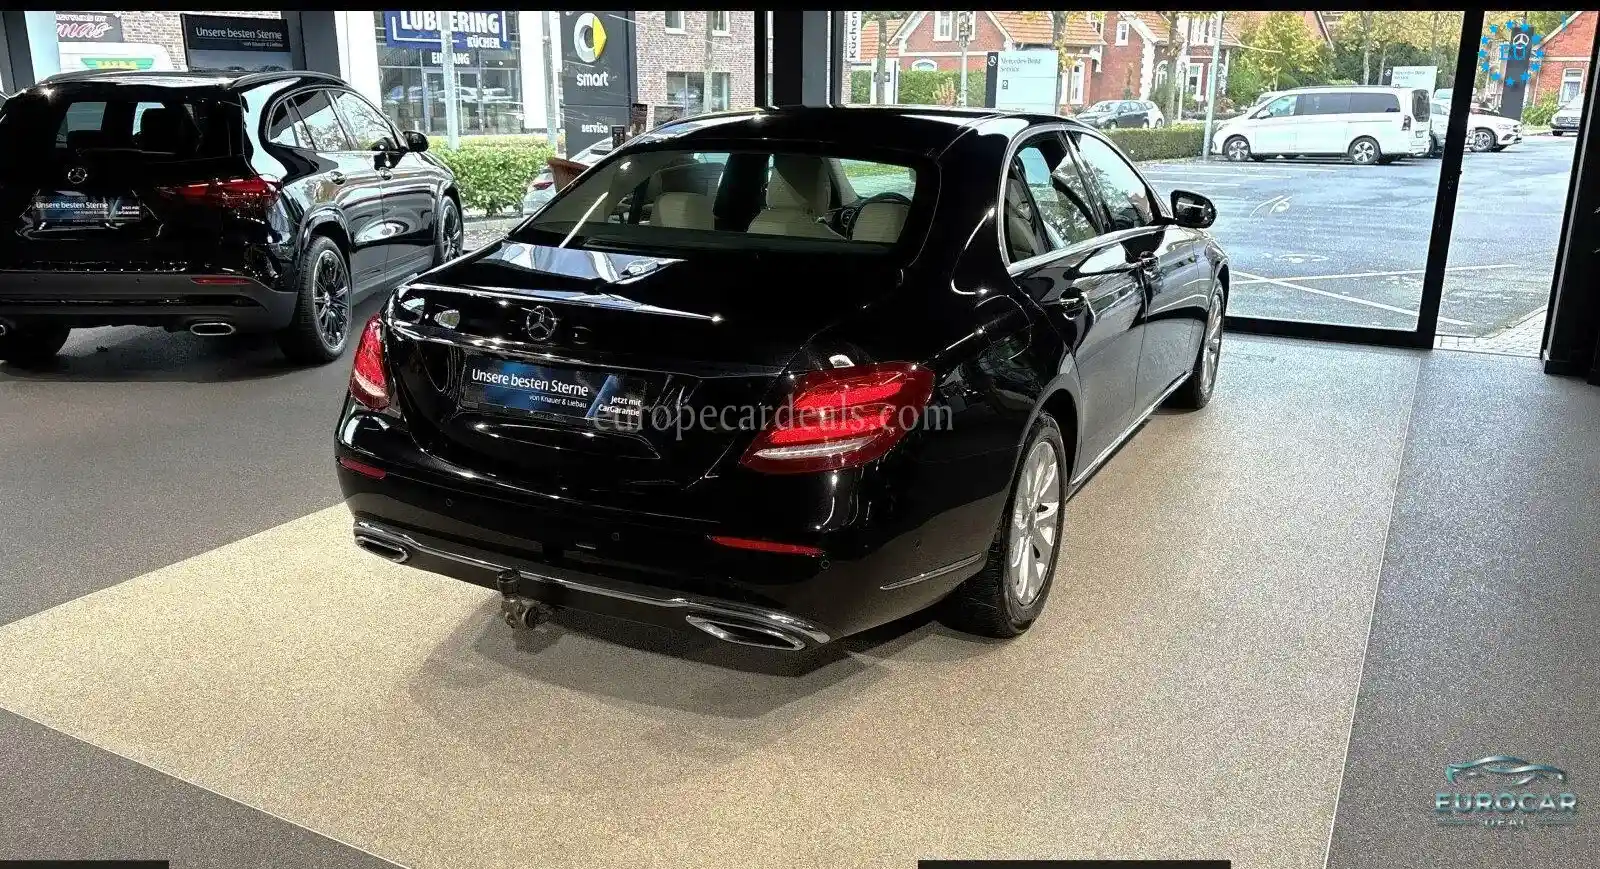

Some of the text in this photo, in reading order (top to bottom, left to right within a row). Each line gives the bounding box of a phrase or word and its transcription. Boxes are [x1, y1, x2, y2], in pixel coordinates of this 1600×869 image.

[400, 11, 500, 34] LUBERING
[195, 27, 283, 40] Unsere besten Sterne
[849, 12, 858, 59] Küchen
[431, 52, 470, 65] EIANG
[576, 71, 609, 87] smart
[581, 122, 609, 134] service
[471, 369, 589, 397] Unsere besten Sterne
[541, 396, 561, 405] Knauer
[567, 400, 587, 409] Liebau
[610, 396, 643, 407] Jetzt mit
[598, 404, 641, 417] CarGarantie
